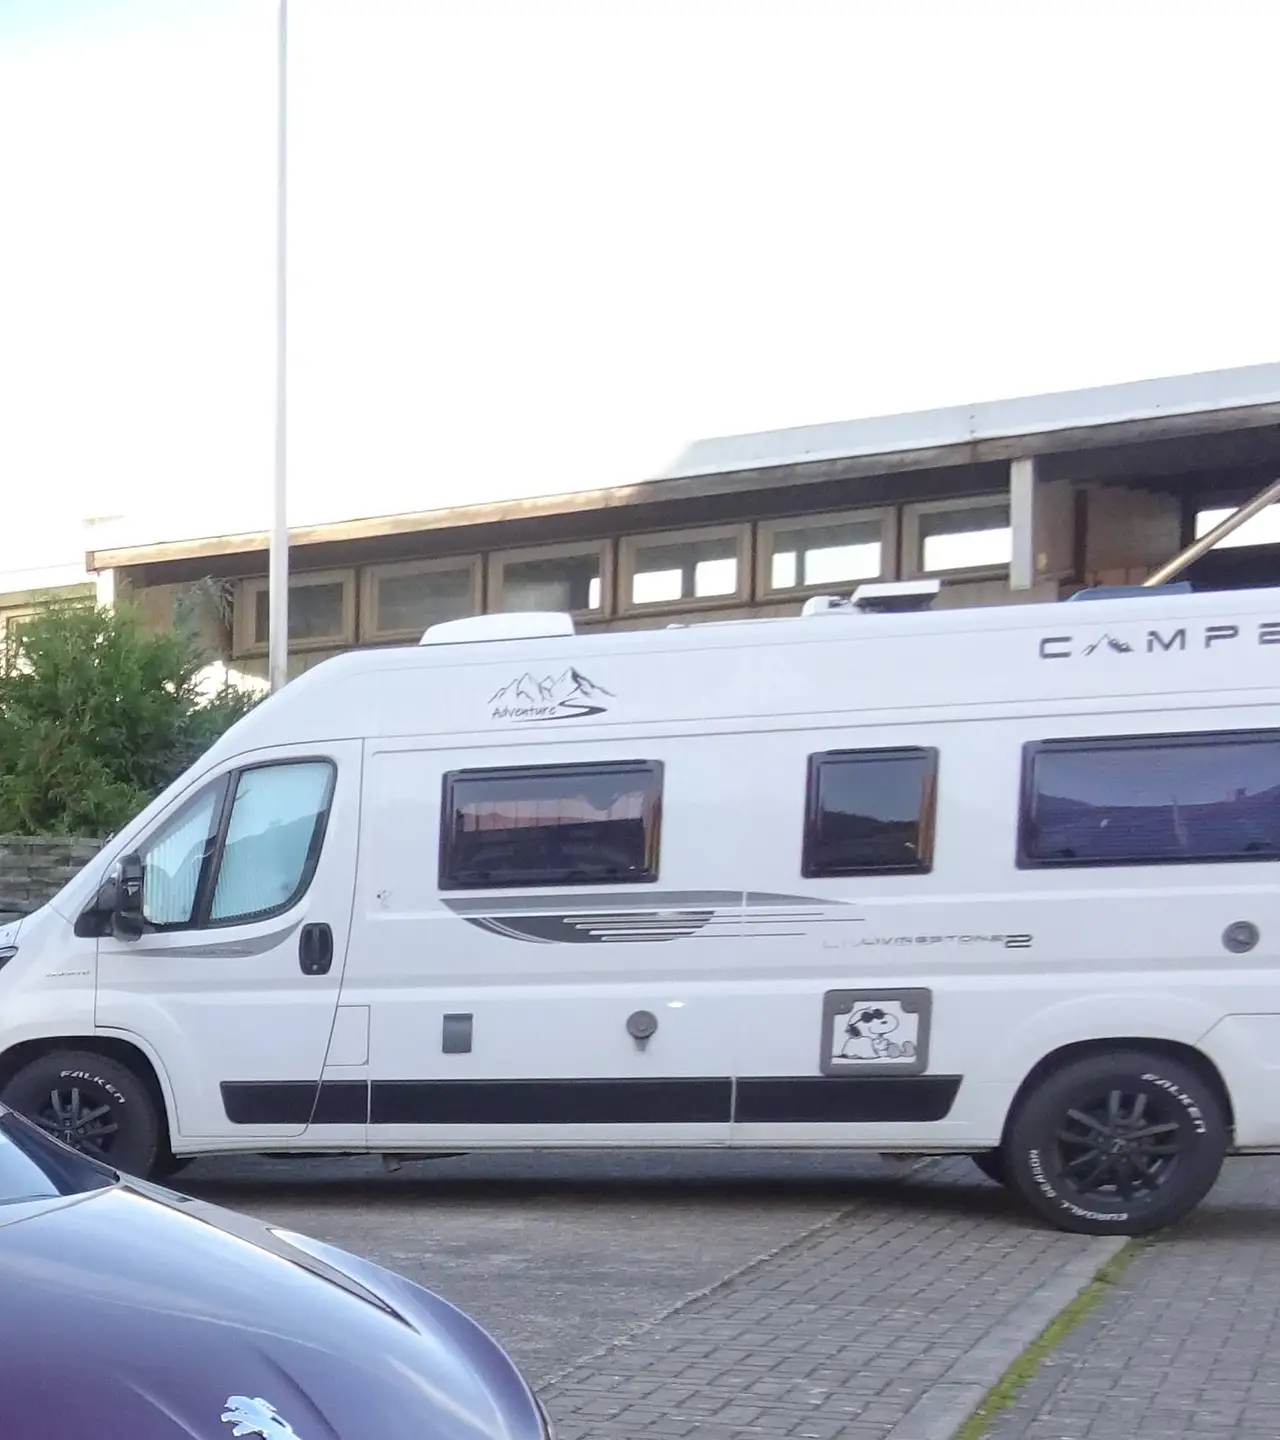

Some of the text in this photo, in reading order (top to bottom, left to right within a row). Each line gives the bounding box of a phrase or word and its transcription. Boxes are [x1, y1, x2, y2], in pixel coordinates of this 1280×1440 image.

[491, 703, 557, 719] Adventure
[60, 1070, 126, 1103] FALKEN
[1141, 1073, 1207, 1133] FALKEN
